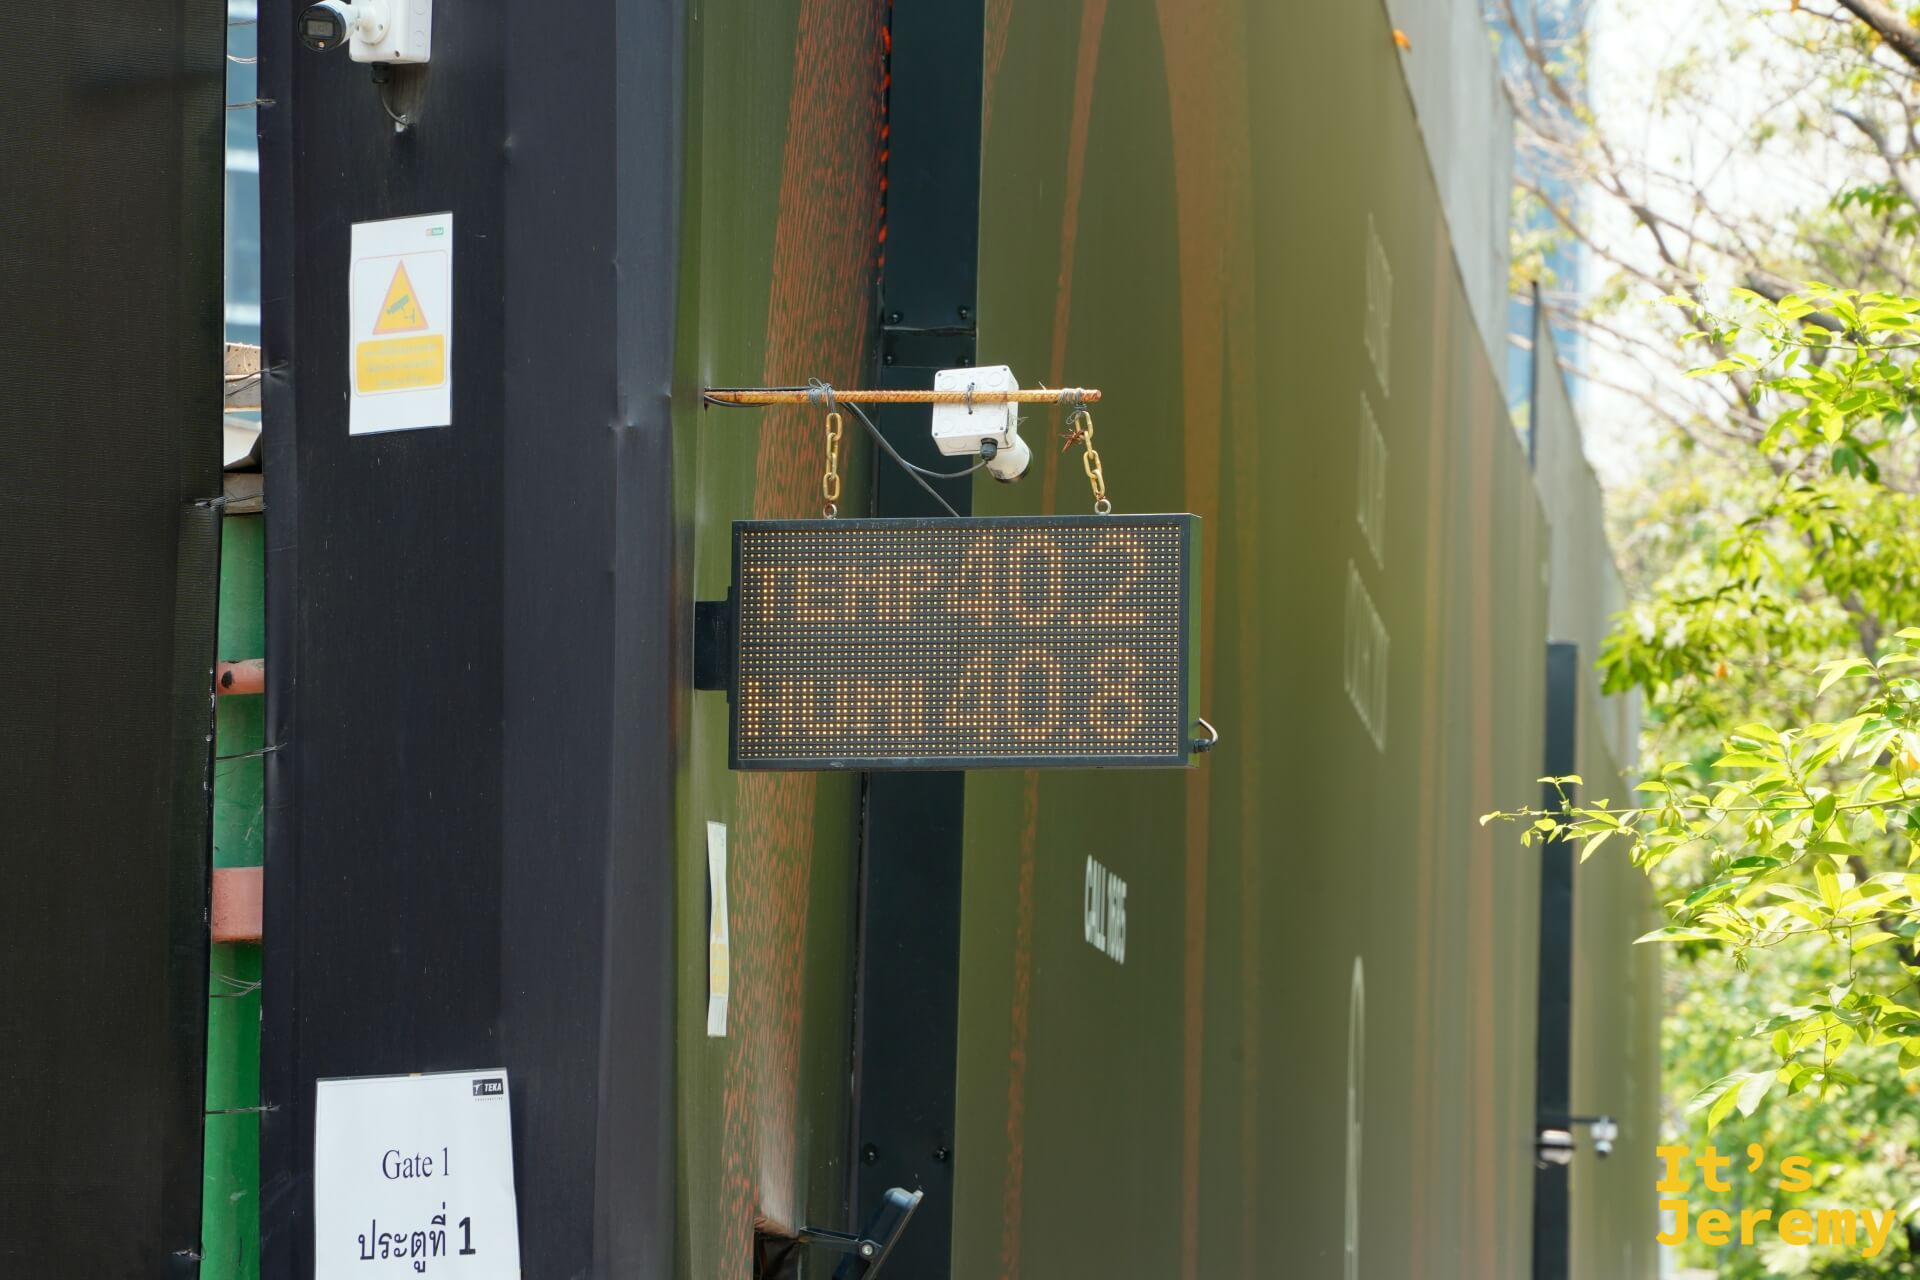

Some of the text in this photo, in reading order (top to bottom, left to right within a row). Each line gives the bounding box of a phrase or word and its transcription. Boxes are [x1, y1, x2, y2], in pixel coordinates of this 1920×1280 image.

[750, 534, 1146, 626] TEMP 40.2
[747, 648, 1144, 741] HUMI 40.8
[1085, 854, 1106, 952] CALL
[484, 1082, 502, 1093] TEKA
[382, 1146, 449, 1179] Gate 1
[358, 1201, 476, 1273] ประตูที่ 1
